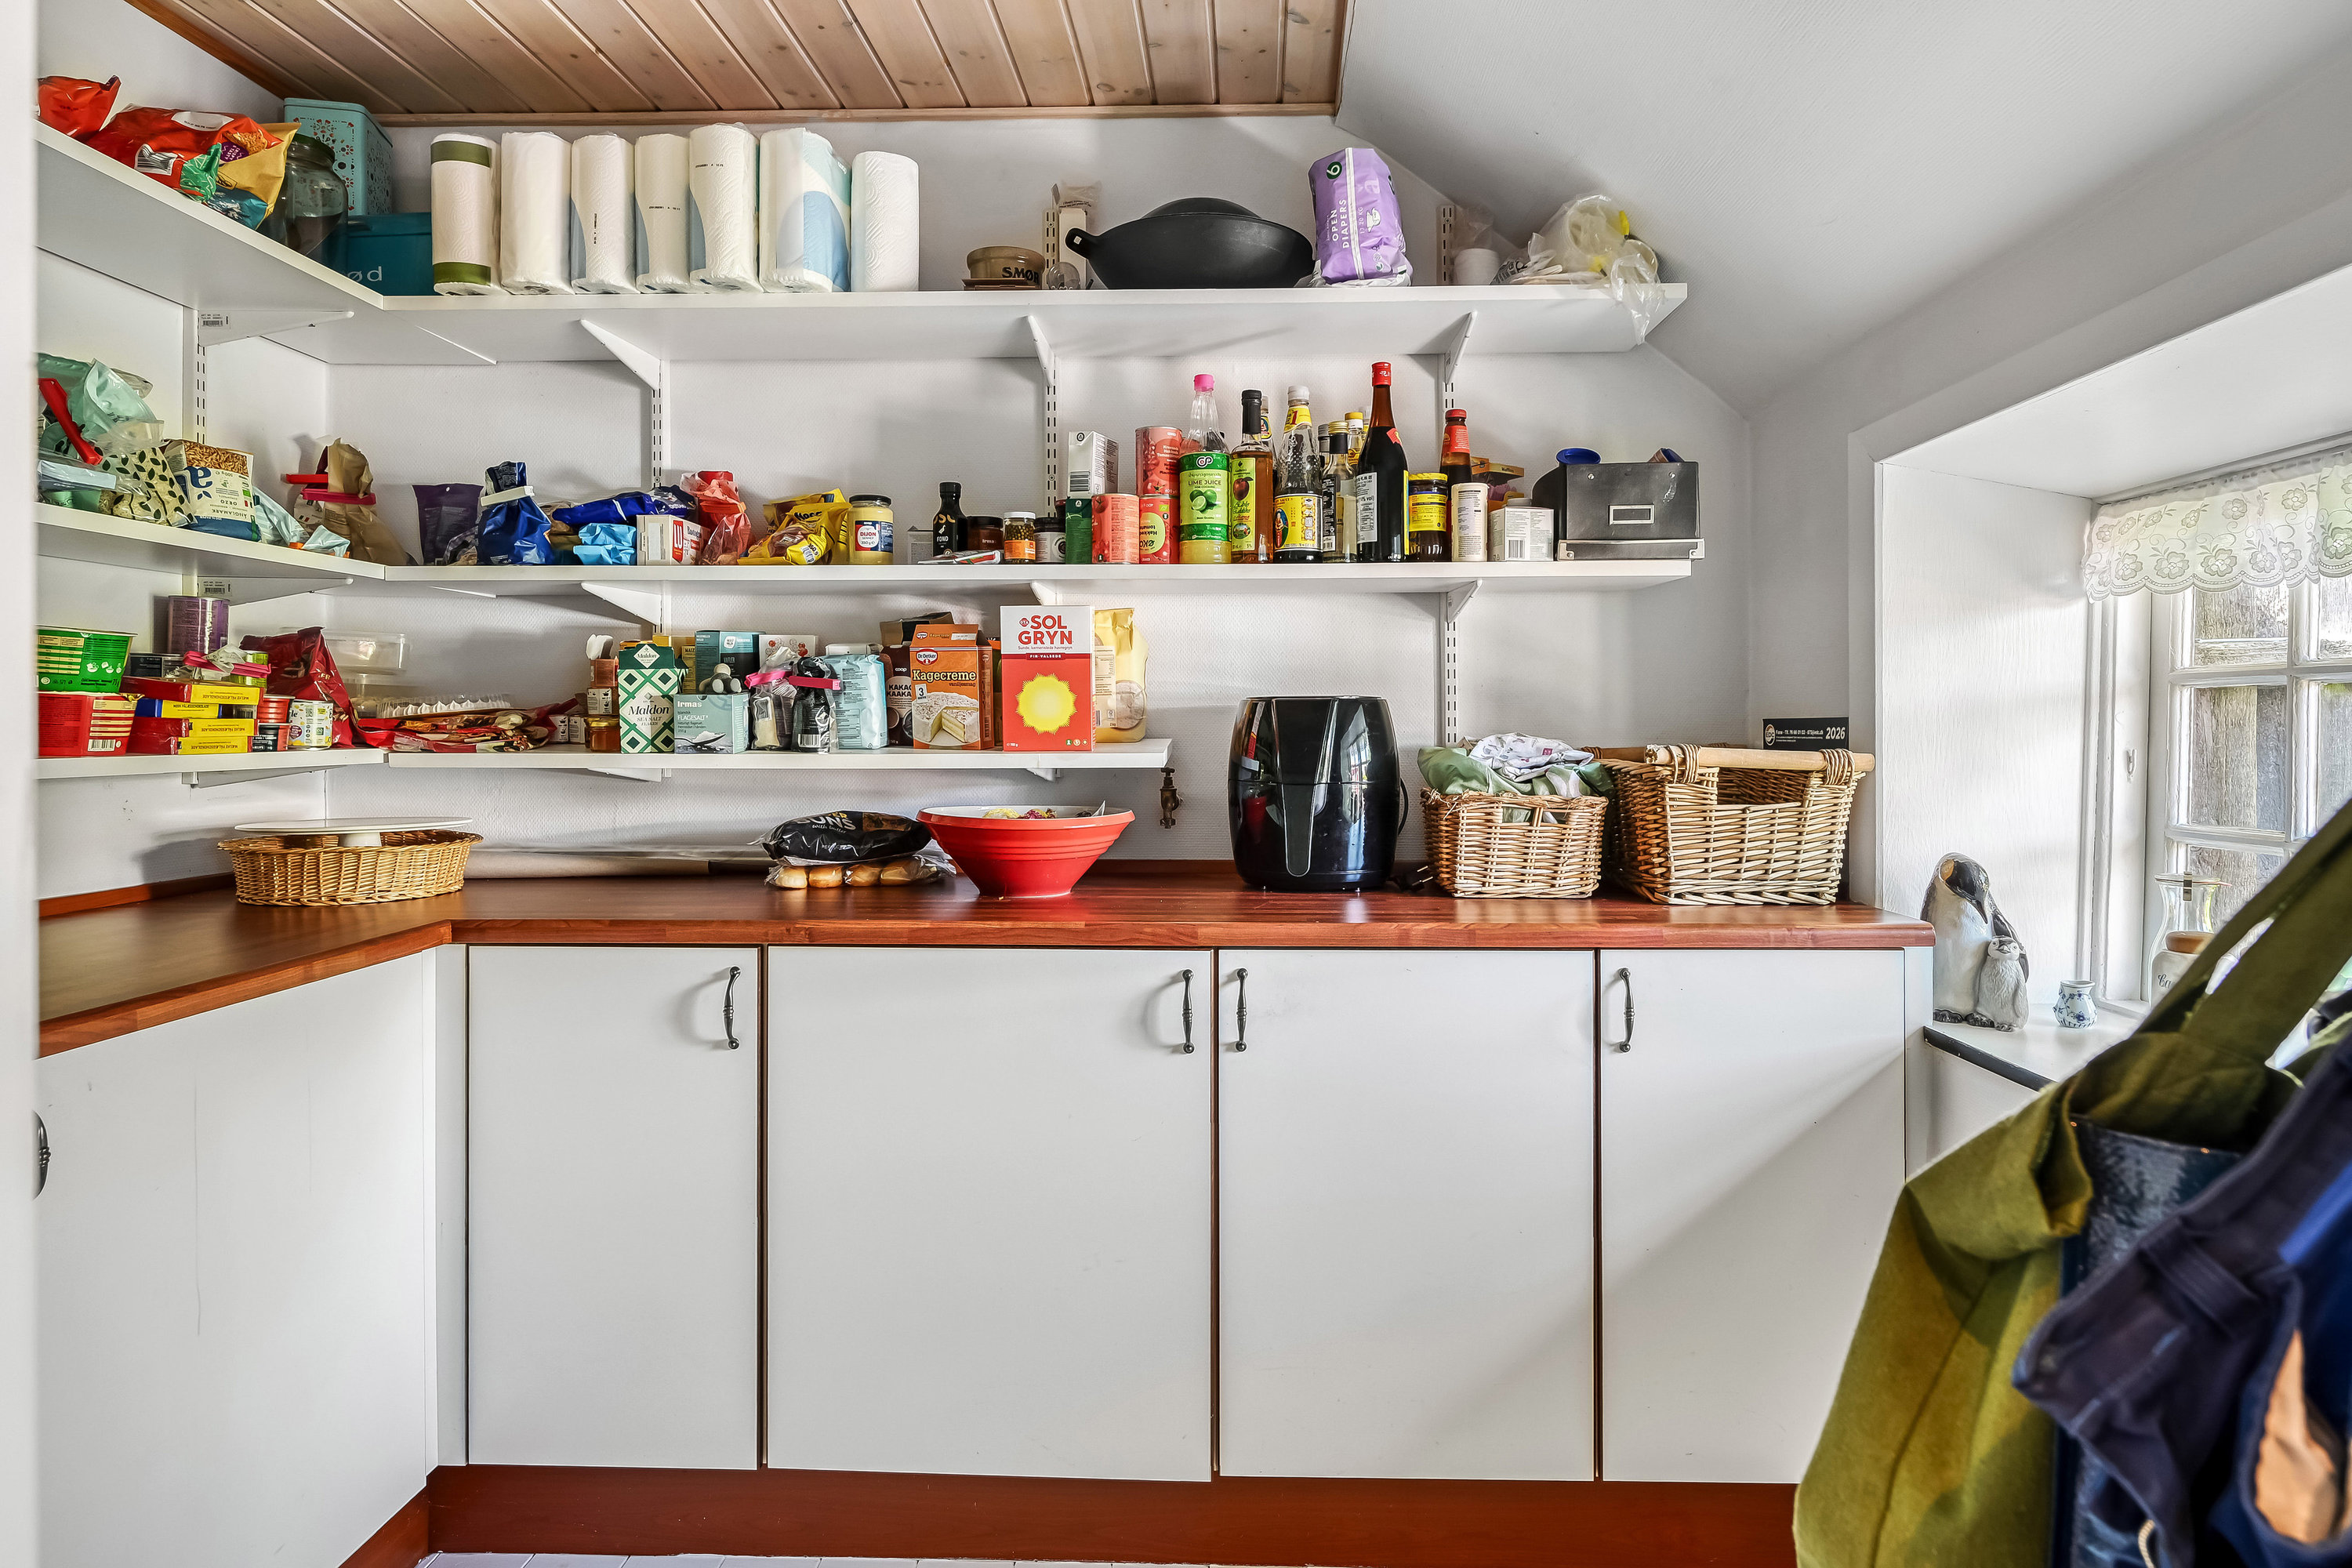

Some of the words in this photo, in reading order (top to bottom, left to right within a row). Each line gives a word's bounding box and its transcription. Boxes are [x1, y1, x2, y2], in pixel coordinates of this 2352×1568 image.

[1326, 163, 1341, 176] 6
[1330, 209, 1339, 241] OPEN
[1339, 199, 1350, 249] DIAPERS
[347, 266, 383, 282] ød
[673, 523, 683, 549] LU
[1030, 615, 1067, 630] SOL
[1018, 630, 1073, 645] GRYN
[913, 670, 976, 683] Kagecreme
[918, 687, 924, 696] 3
[628, 706, 670, 716] Maldon
[1825, 727, 1846, 739] 2026
